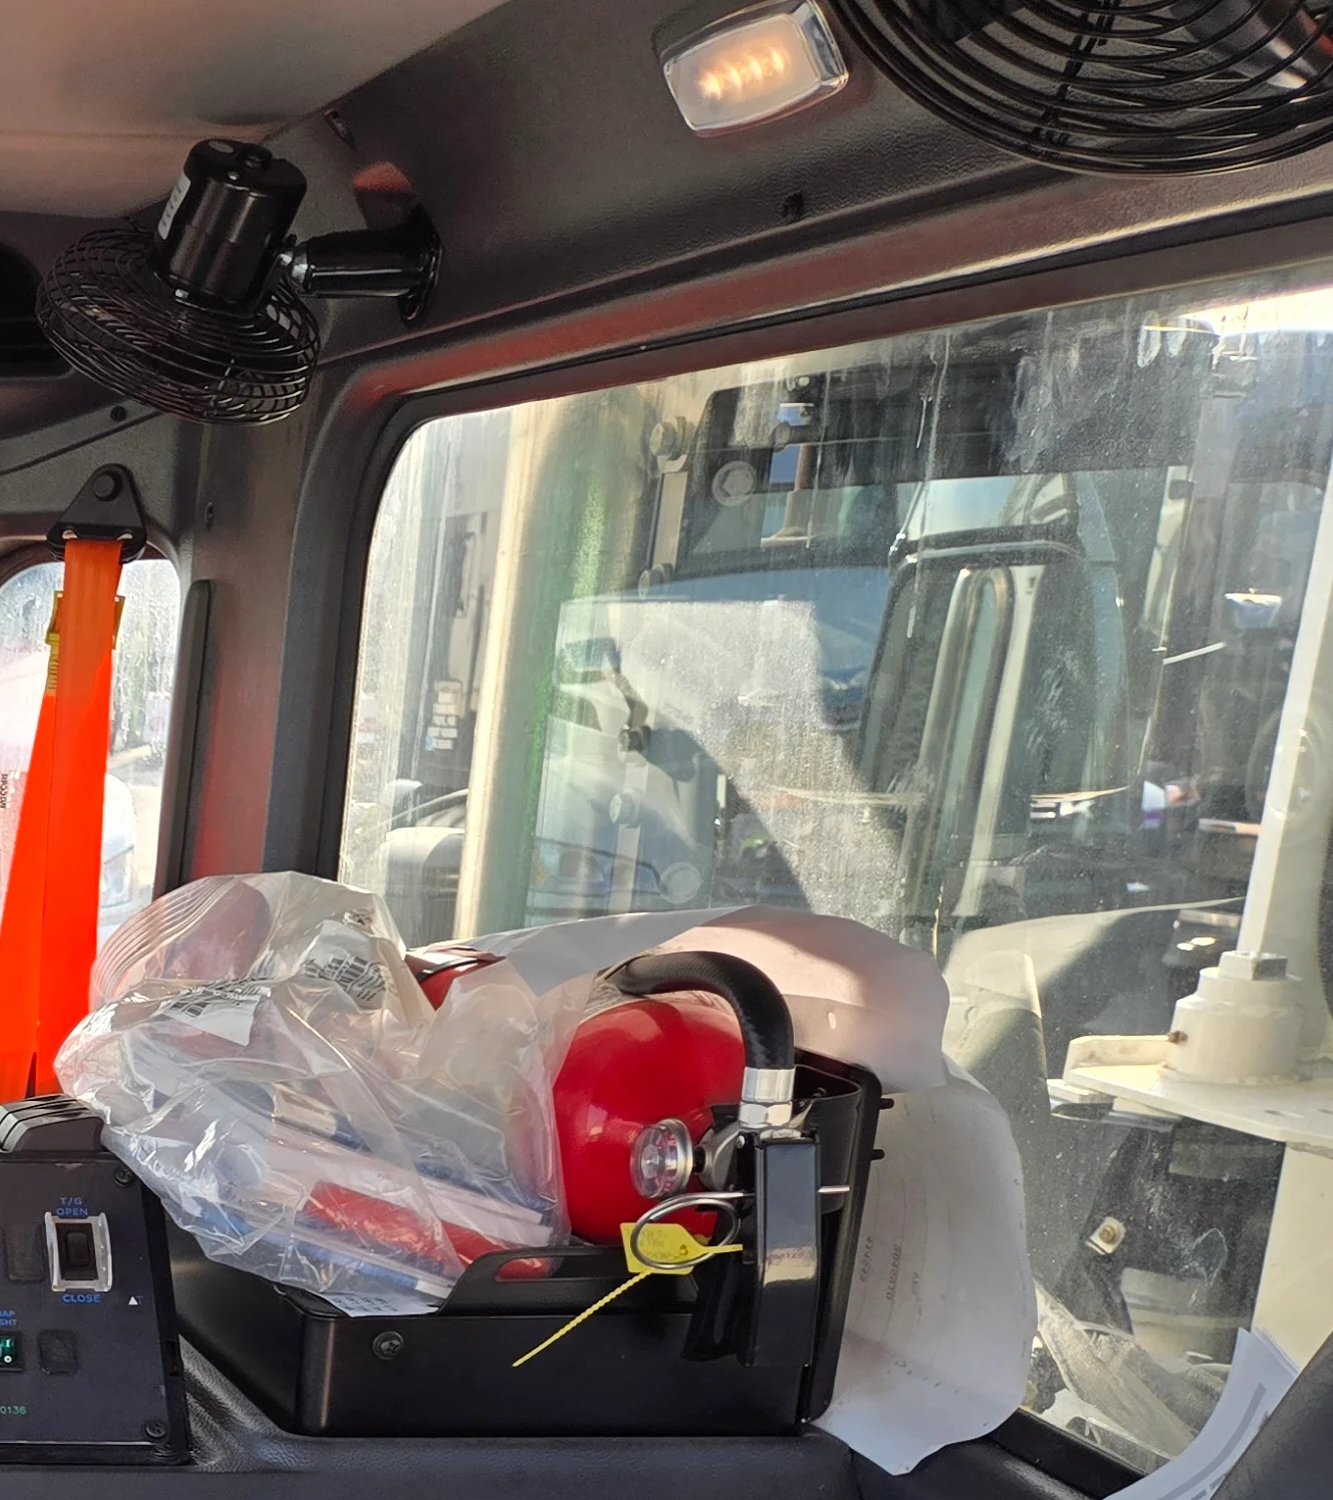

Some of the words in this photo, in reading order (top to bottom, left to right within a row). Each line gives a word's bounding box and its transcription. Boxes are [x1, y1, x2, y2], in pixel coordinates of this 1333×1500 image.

[60, 1197, 83, 1205] T/G
[56, 1207, 89, 1216] OPEN
[62, 1294, 102, 1303] CLOSE
